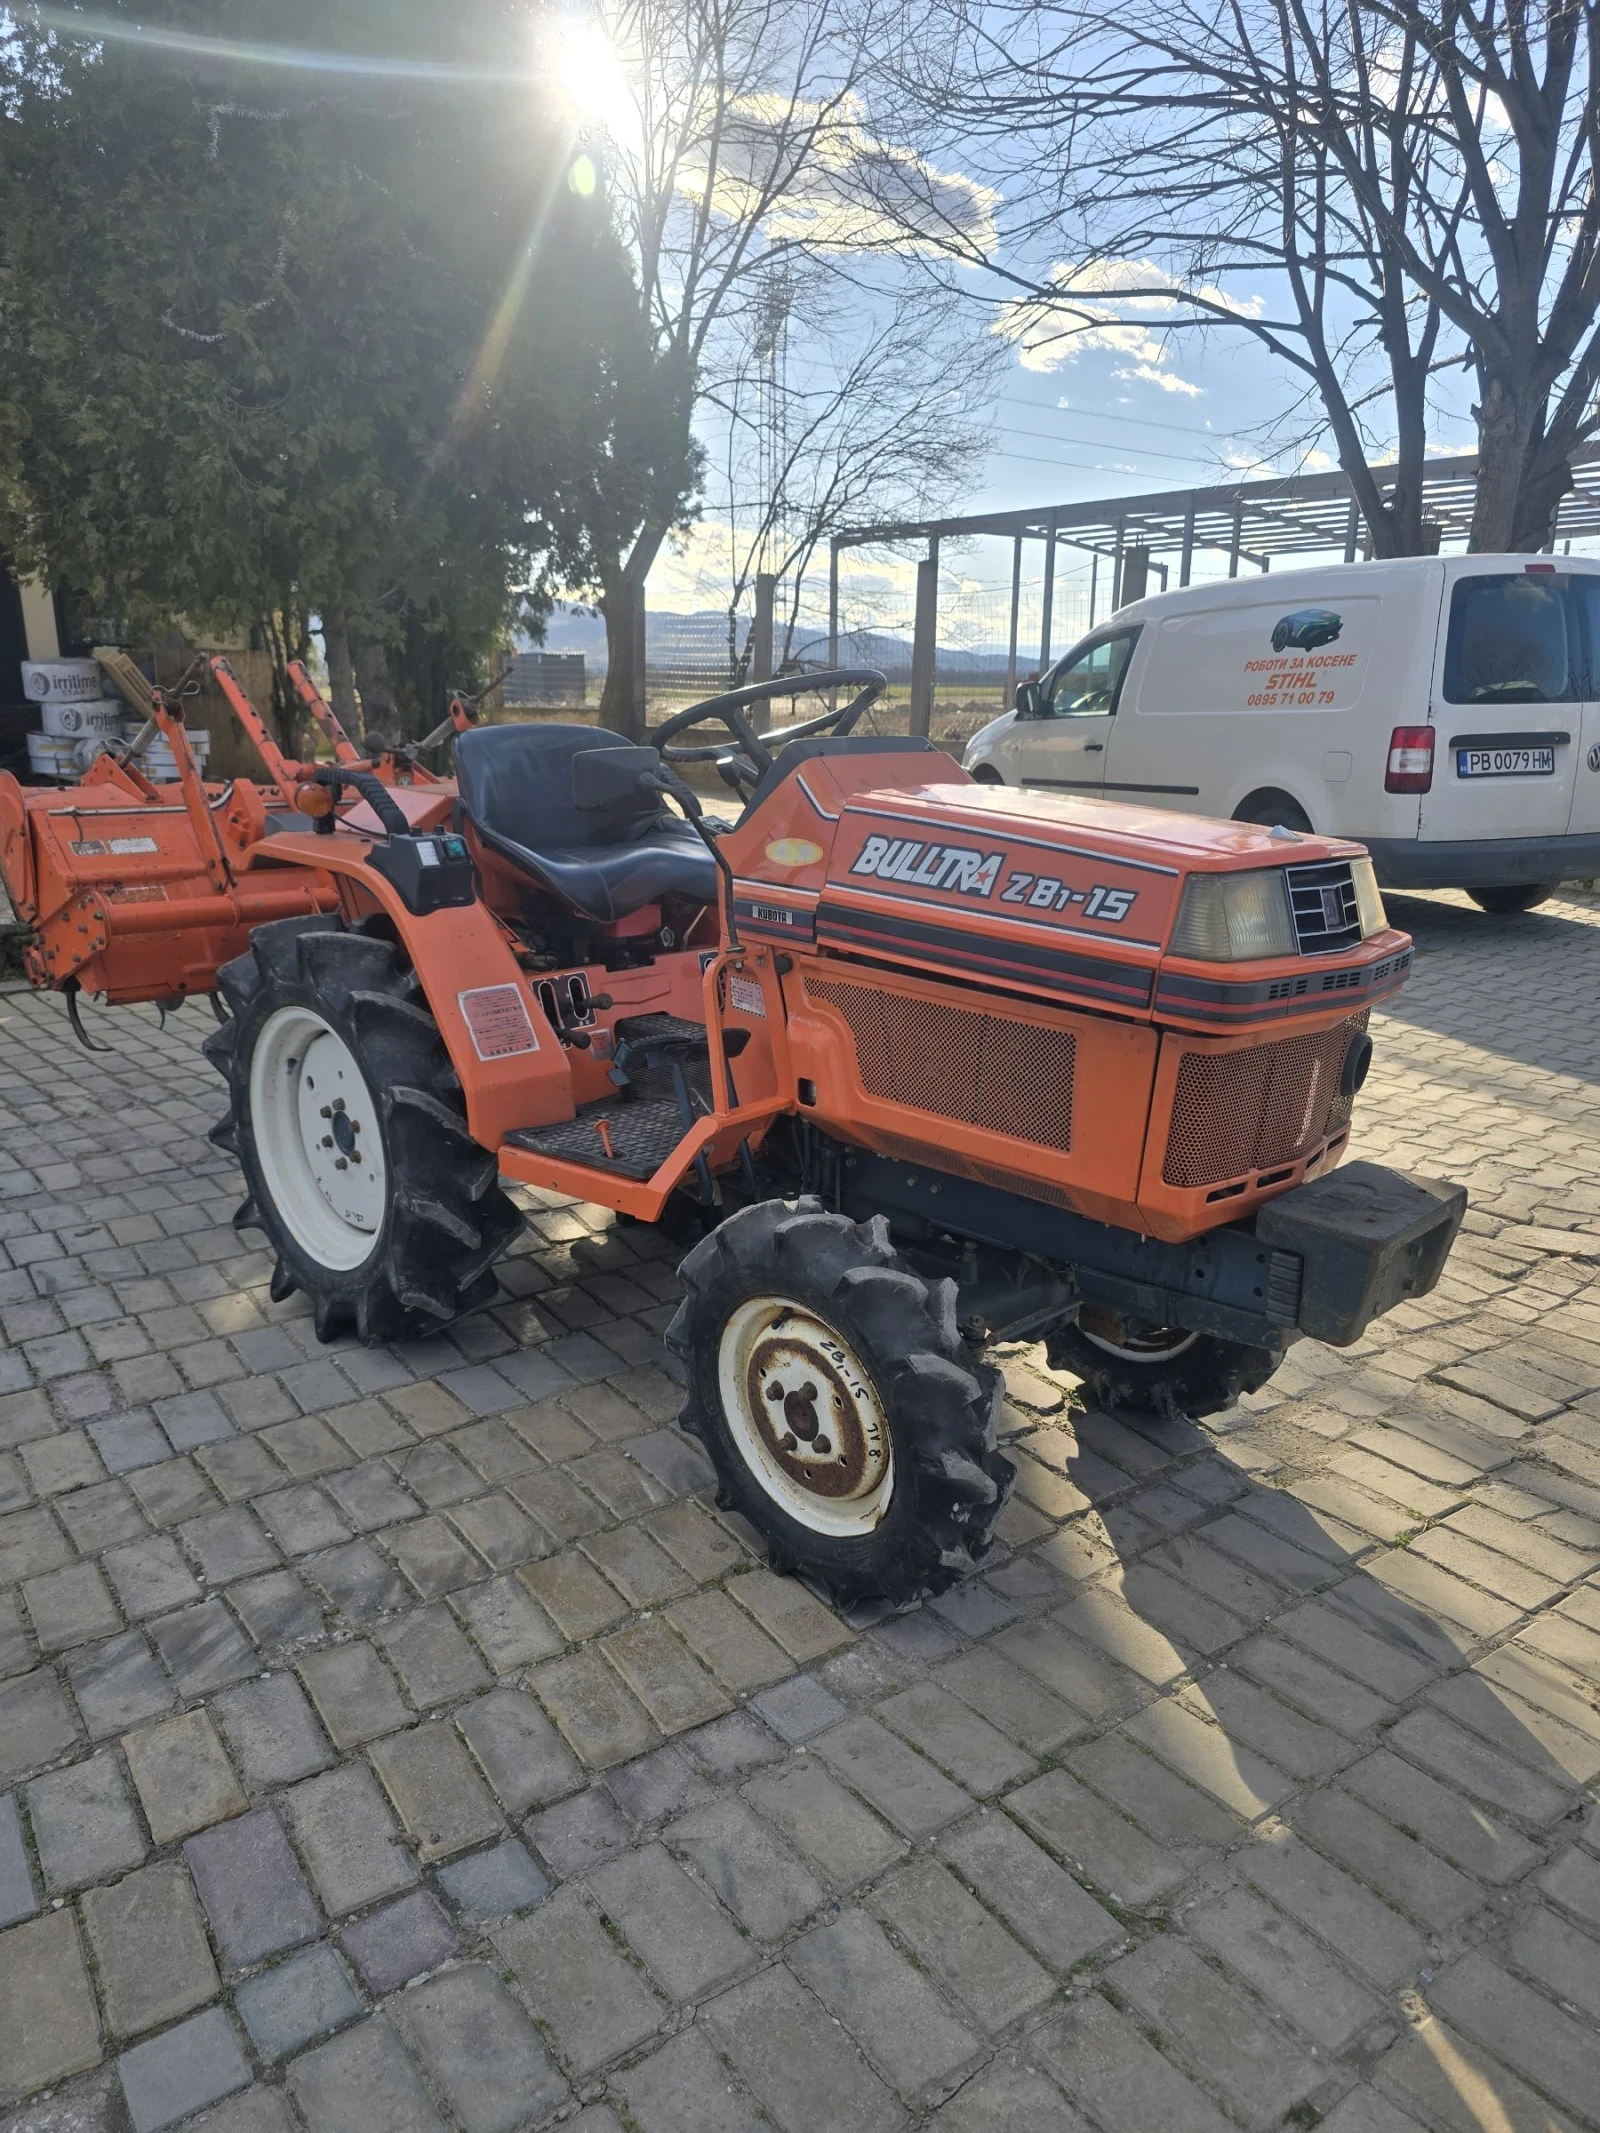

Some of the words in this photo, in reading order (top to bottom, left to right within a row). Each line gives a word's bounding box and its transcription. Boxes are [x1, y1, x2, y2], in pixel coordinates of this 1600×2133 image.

[1244, 658, 1288, 672] РОБОТИ
[1289, 658, 1304, 669] ЗА
[1306, 654, 1357, 668] КОСЕНЕ
[52, 674, 98, 689] irritime
[1265, 671, 1317, 690] STIHL
[1247, 693, 1278, 706] 0895
[1280, 692, 1294, 704] 71
[1297, 691, 1315, 704] 00
[1318, 690, 1335, 703] 79
[1470, 753, 1491, 771] PB
[1494, 751, 1530, 770] 0079
[850, 834, 1004, 897] BULLTRA
[757, 906, 787, 923] KUBOTA
